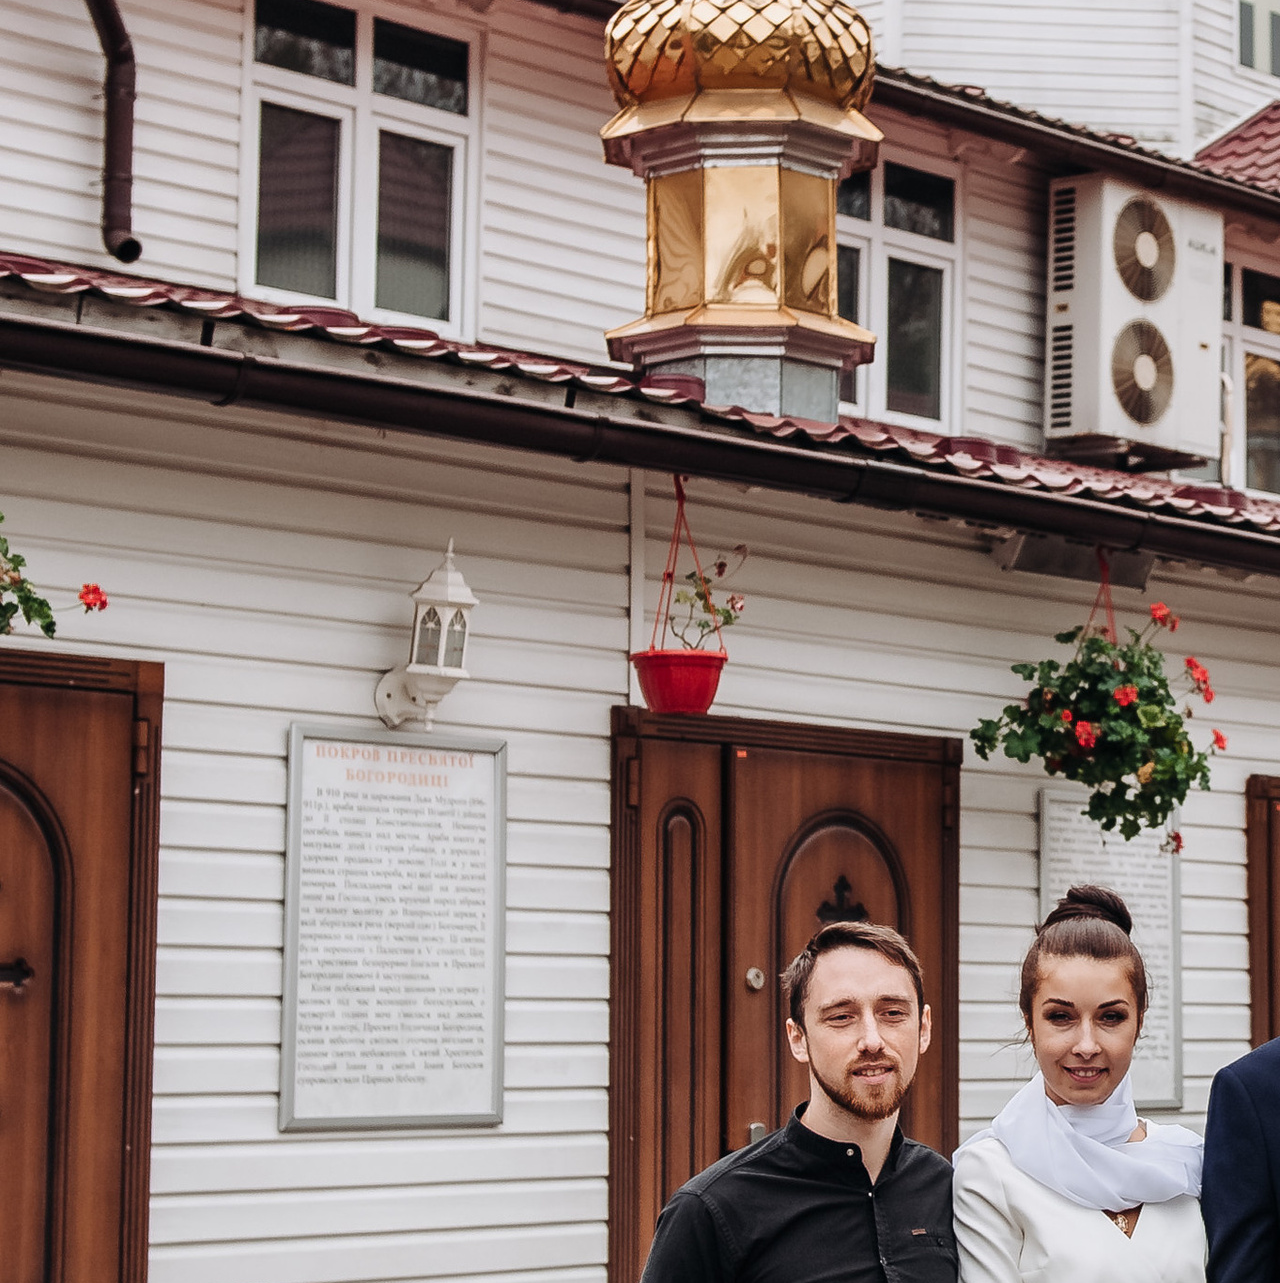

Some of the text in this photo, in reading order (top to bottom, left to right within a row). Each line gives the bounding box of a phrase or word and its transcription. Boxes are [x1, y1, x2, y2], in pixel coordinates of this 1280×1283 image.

[315, 744, 473, 769] ПОКРОВ ПРЕСВЯТОЇ
[345, 768, 448, 787] БОГОРОДИЦІ
